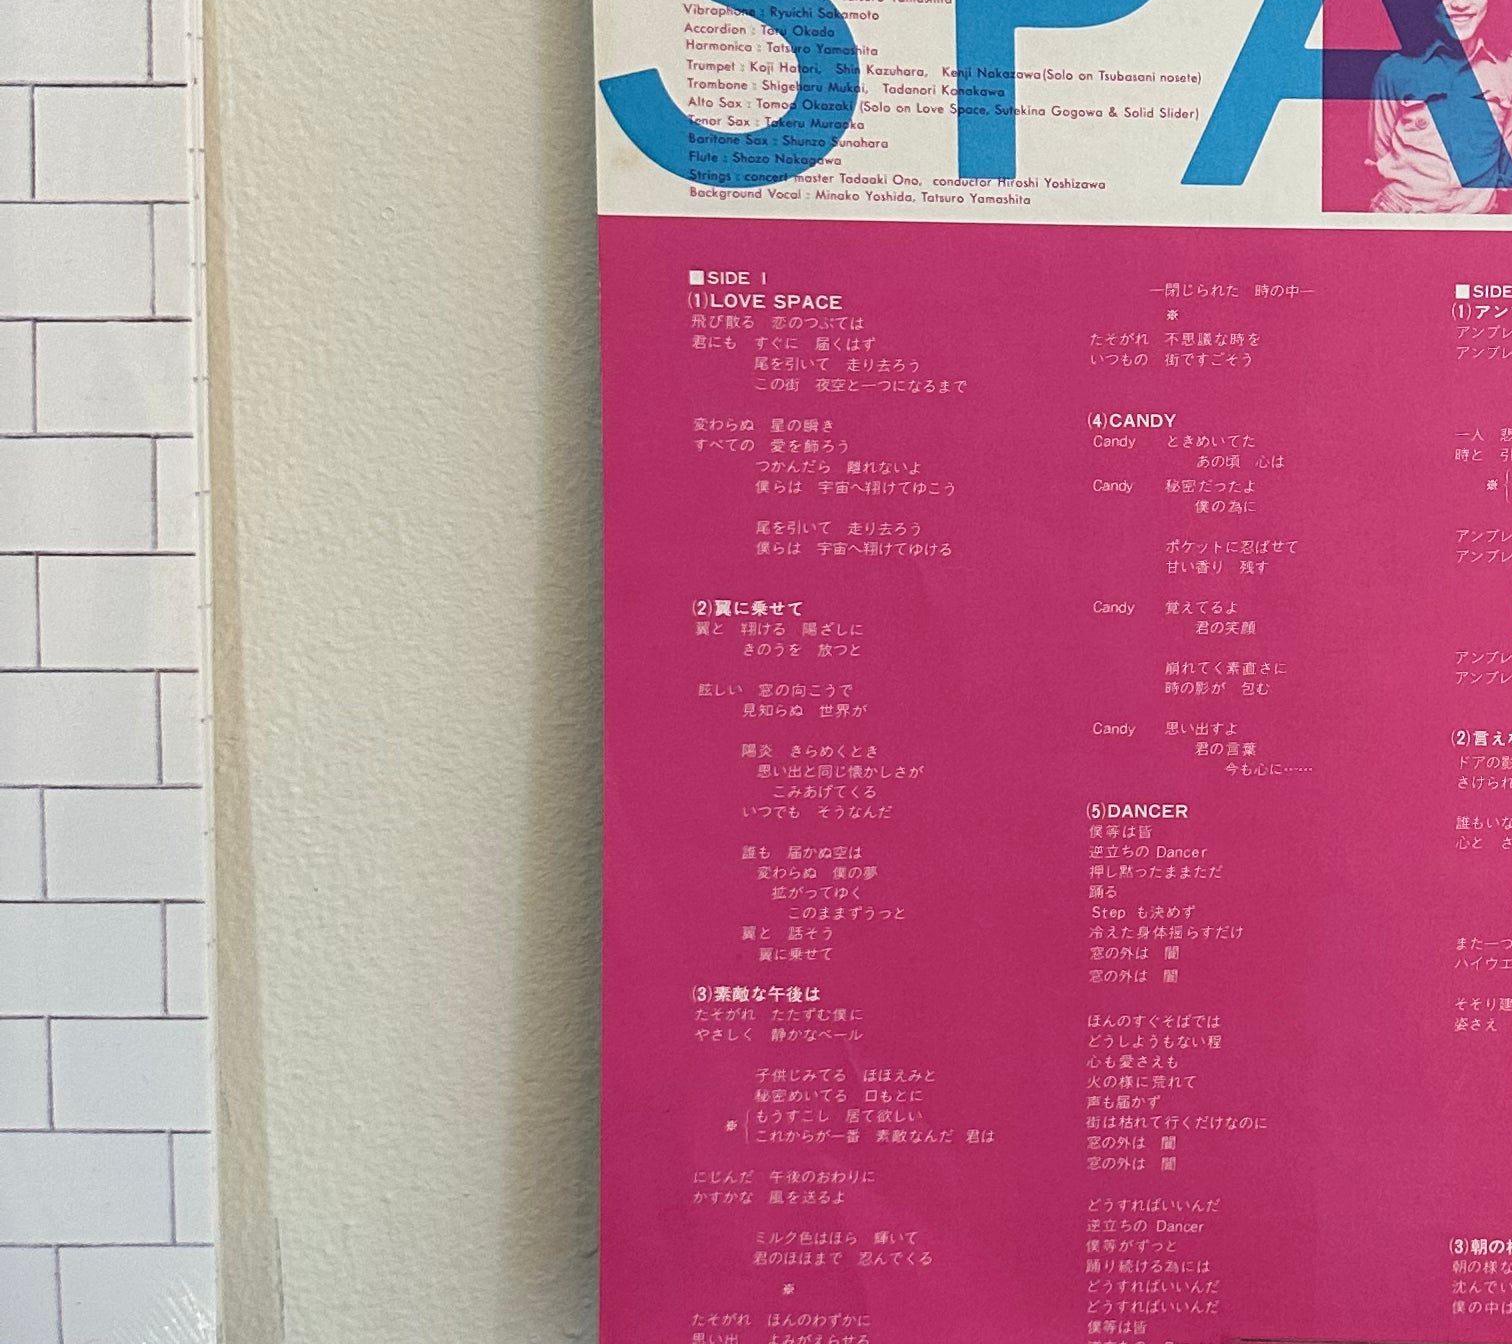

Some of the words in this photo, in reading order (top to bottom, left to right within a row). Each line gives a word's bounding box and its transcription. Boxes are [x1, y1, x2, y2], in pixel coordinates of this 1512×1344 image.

[690, 187, 761, 199] Background
[768, 189, 800, 199] Vocal
[816, 190, 859, 201] Minako
[922, 192, 964, 203] Tatsuro
[970, 193, 1030, 205] Yamashita
[708, 271, 750, 284] SIDE
[1473, 285, 1512, 298] SIDE
[774, 295, 842, 310] SPACE
[1093, 436, 1136, 448] Candy
[1093, 480, 1133, 493] Candy
[1093, 601, 1135, 615] Candy
[1093, 722, 1135, 737] Candy
[1156, 845, 1207, 859] Dancer
[1092, 906, 1126, 920] Step
[1157, 1219, 1204, 1233] Dancer
